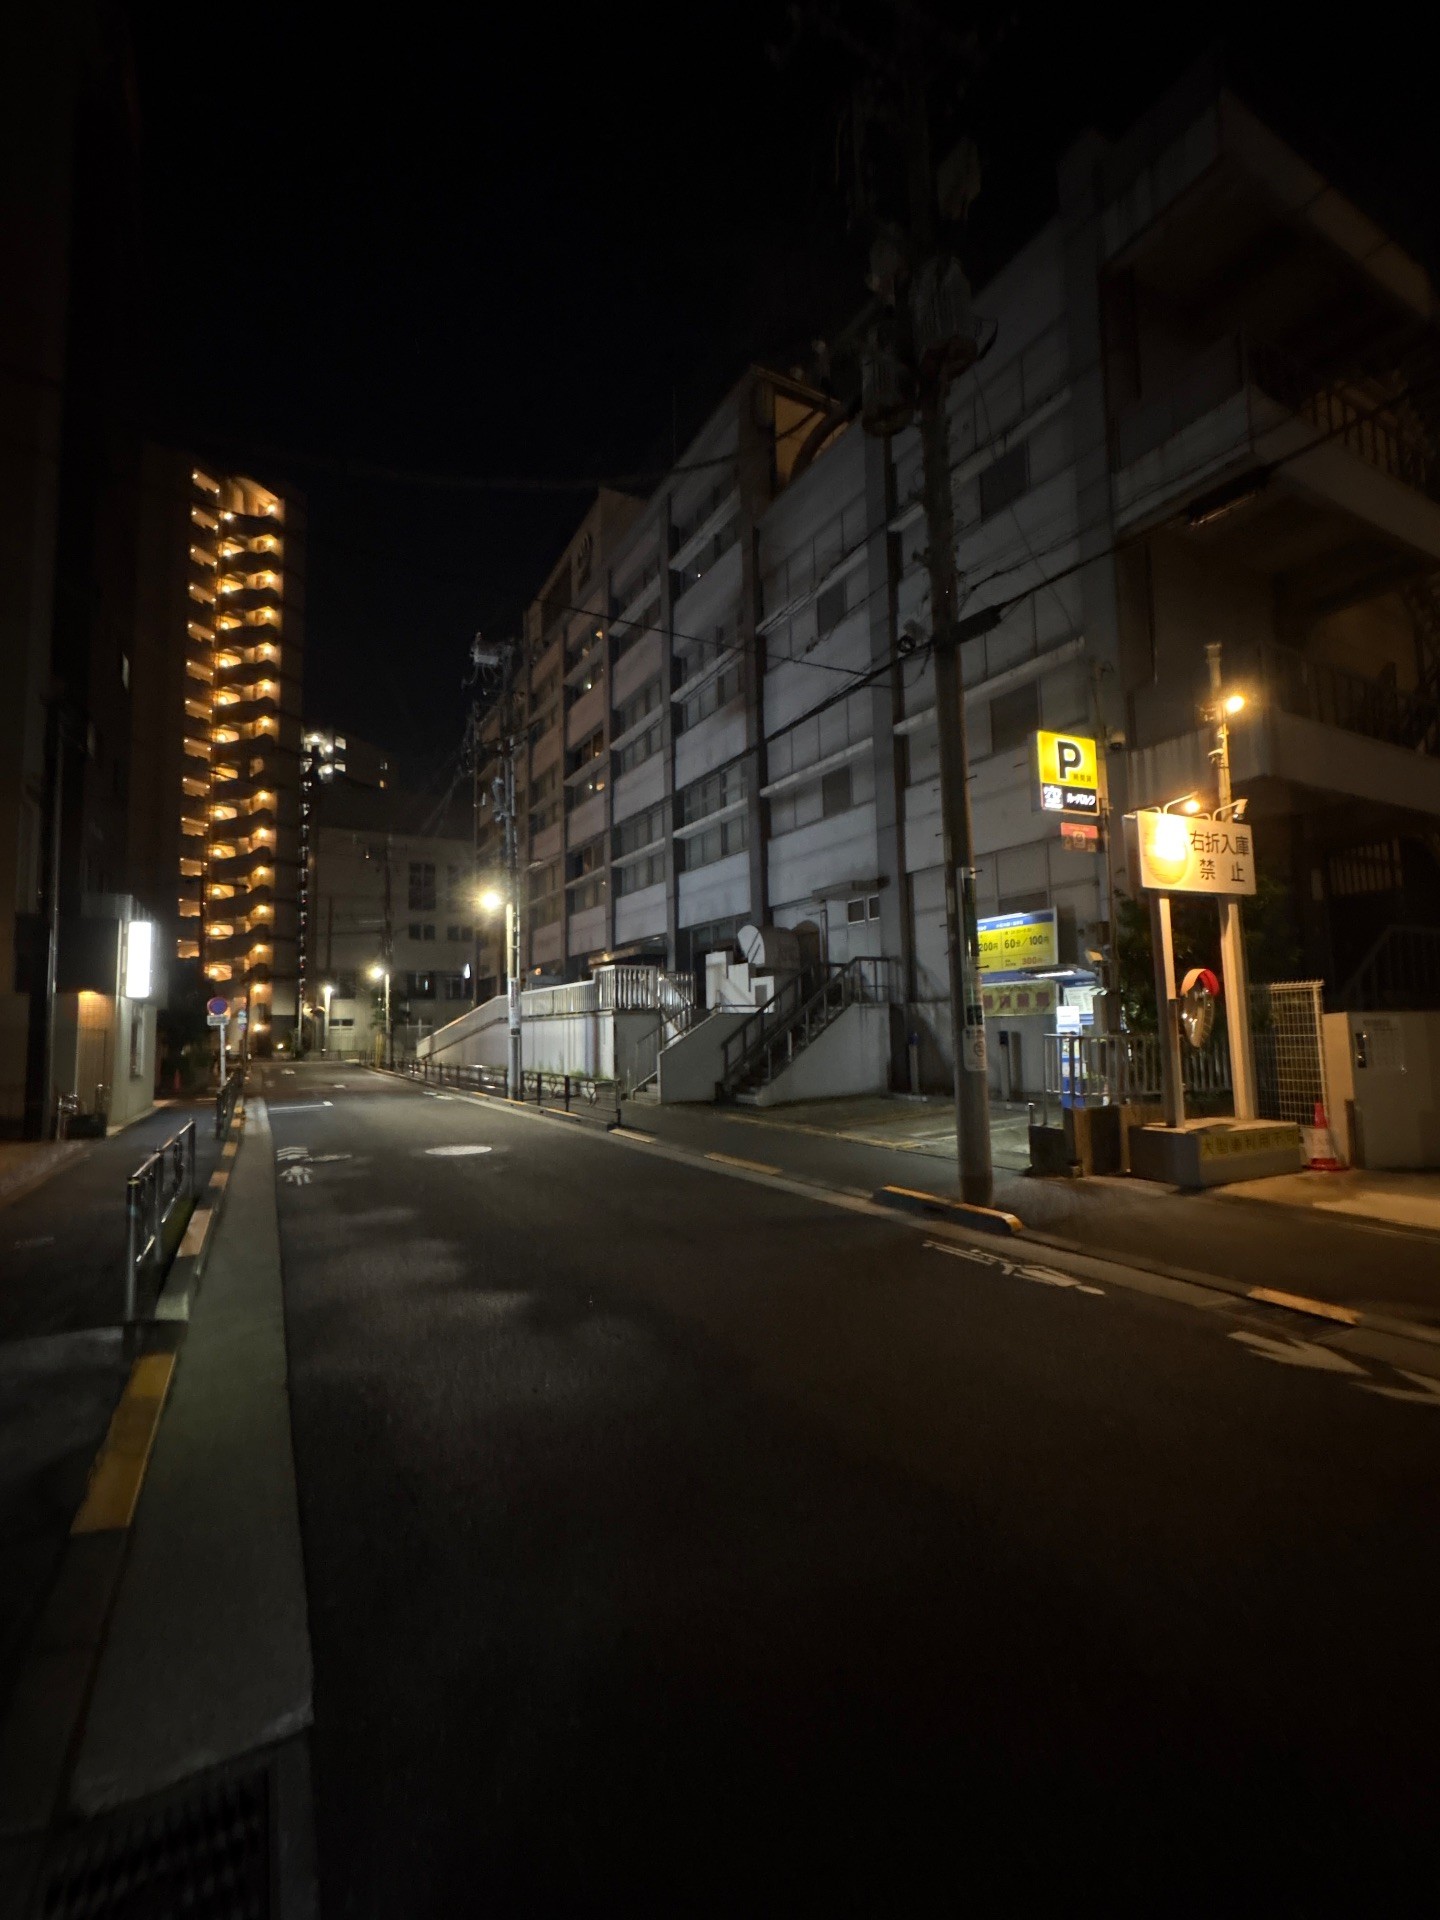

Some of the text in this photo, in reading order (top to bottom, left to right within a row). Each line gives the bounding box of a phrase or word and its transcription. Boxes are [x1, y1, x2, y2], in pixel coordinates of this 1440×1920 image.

[1057, 741, 1082, 779] P
[1044, 786, 1064, 808] 空
[1189, 831, 1249, 856] 右折入庫
